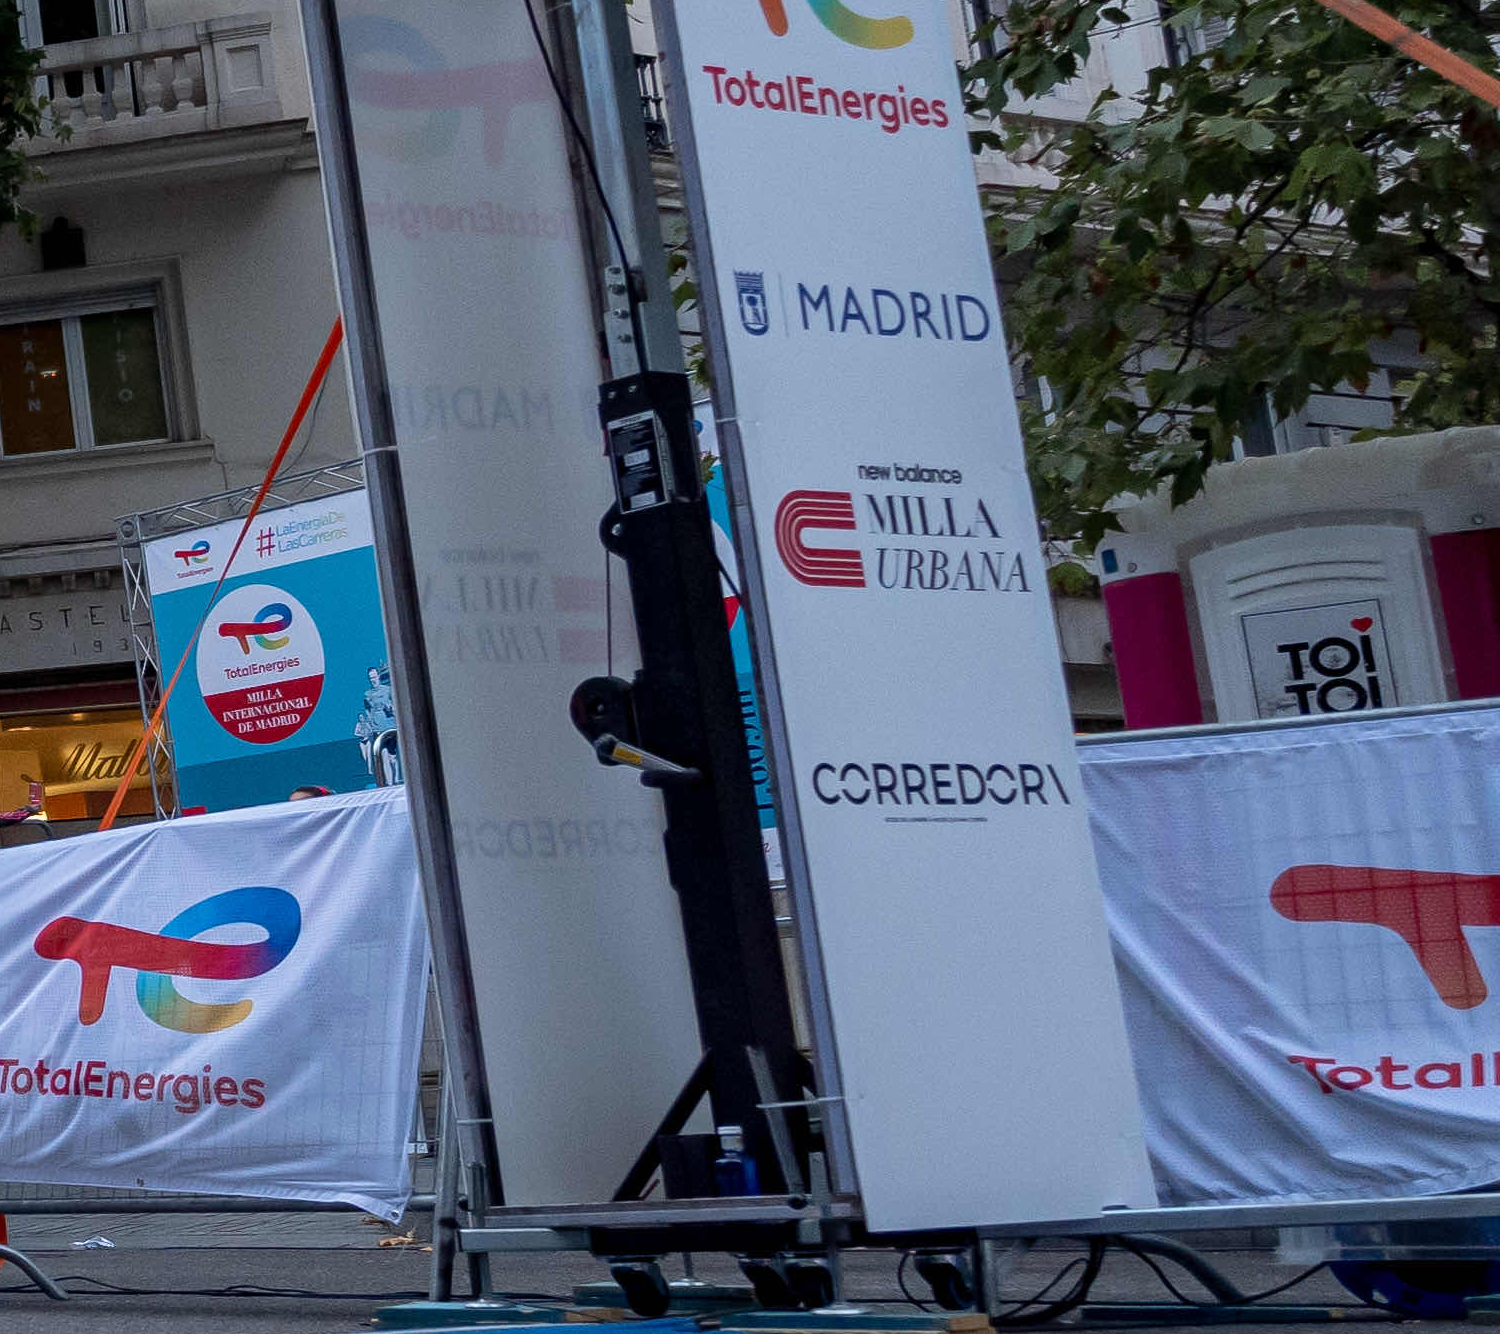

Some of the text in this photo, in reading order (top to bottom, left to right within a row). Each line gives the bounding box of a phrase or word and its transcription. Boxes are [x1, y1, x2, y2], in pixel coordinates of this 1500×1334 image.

[702, 64, 950, 135] TotalEnergies
[798, 282, 991, 343] MADRID
[856, 461, 963, 486] new balance
[864, 494, 1003, 540] MILLA
[875, 547, 1033, 594] URBANA
[224, 656, 301, 681] TotalEnergies
[245, 687, 283, 705] MILLA
[255, 712, 301, 733] MADRID
